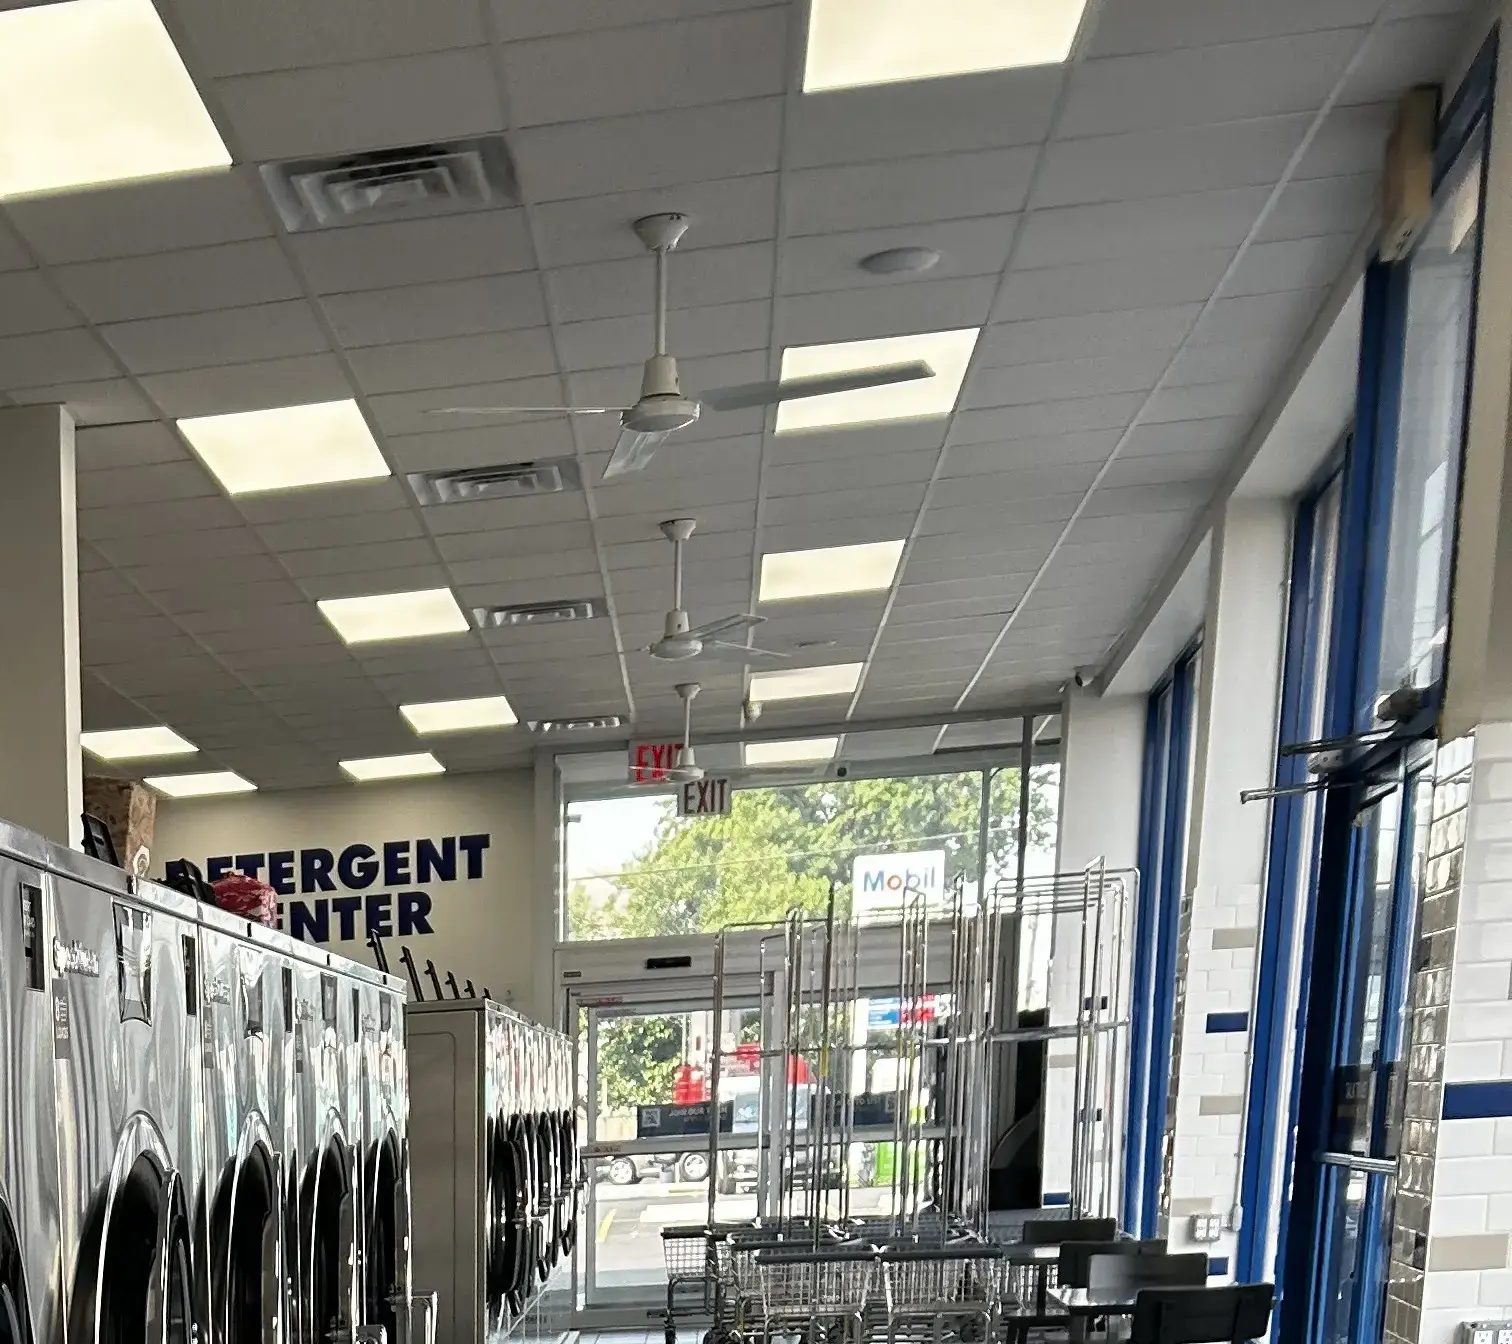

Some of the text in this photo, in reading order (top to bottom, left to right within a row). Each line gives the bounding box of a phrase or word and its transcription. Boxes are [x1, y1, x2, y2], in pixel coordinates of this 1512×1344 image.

[684, 778, 728, 814] EXIT
[863, 866, 935, 892] Mobil
[276, 891, 436, 944] NTER
